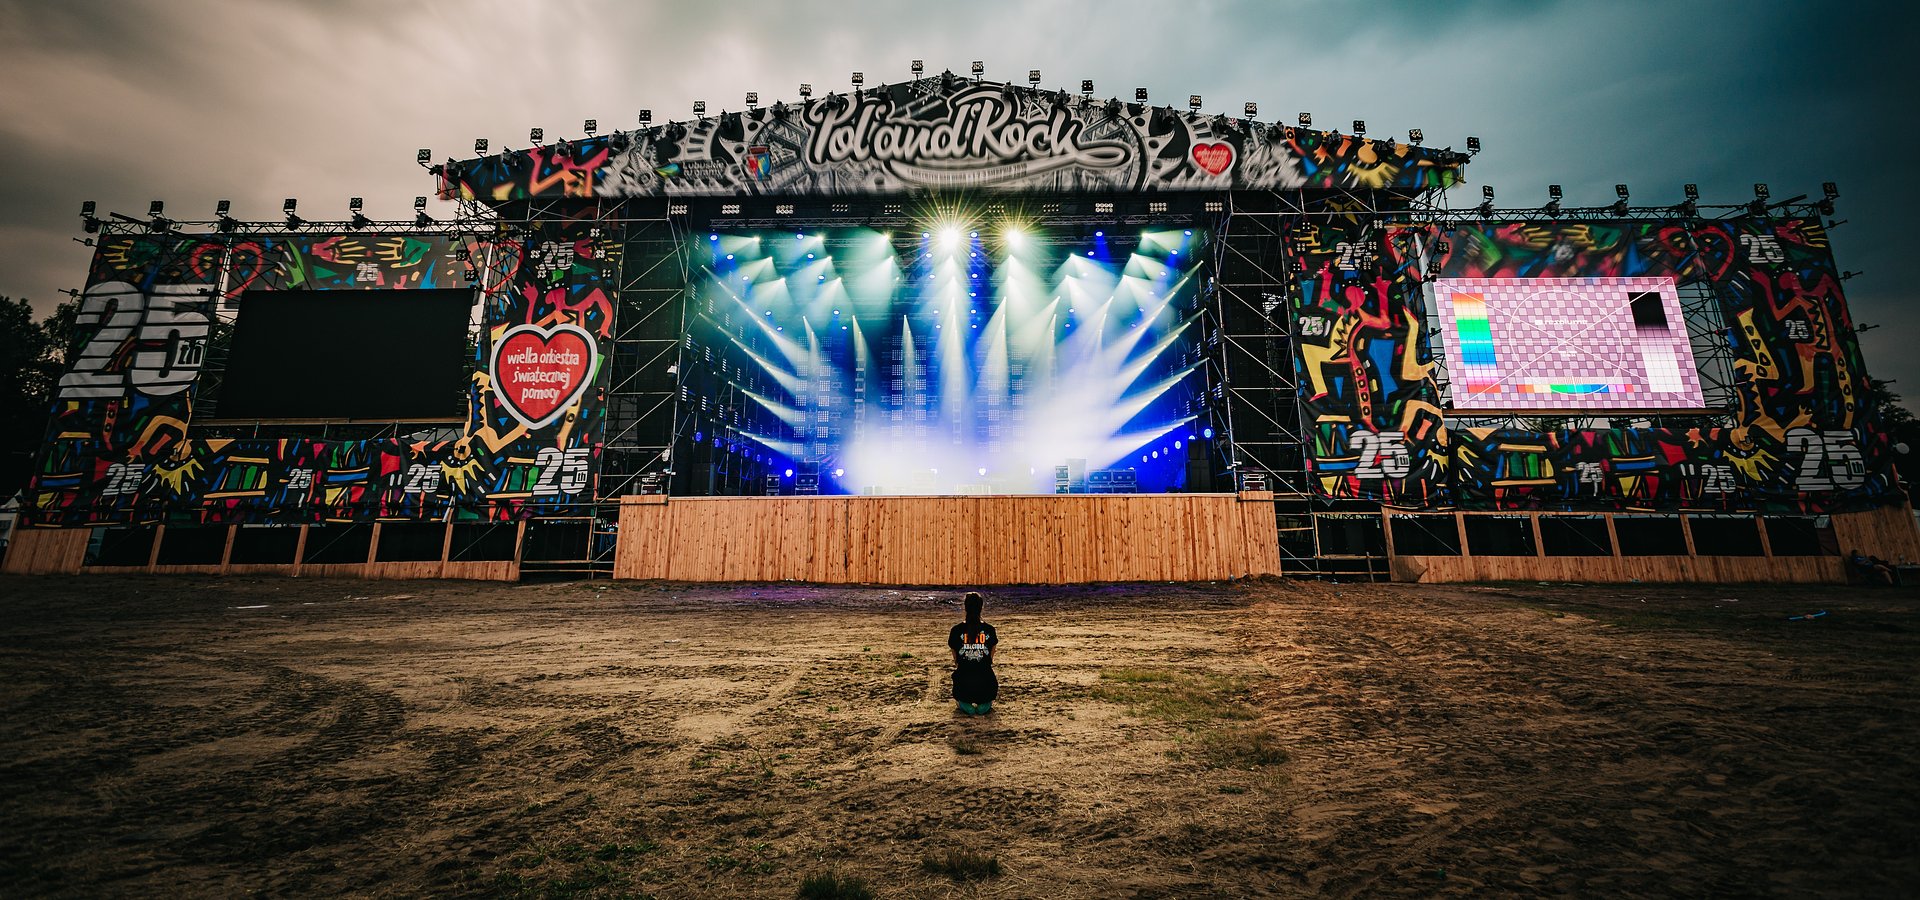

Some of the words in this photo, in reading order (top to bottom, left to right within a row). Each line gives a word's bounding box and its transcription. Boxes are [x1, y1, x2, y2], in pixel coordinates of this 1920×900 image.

[507, 346, 538, 365] wielka
[539, 348, 580, 365] orkiestra
[512, 366, 571, 390] świątecznej
[521, 387, 561, 405] pomocy
